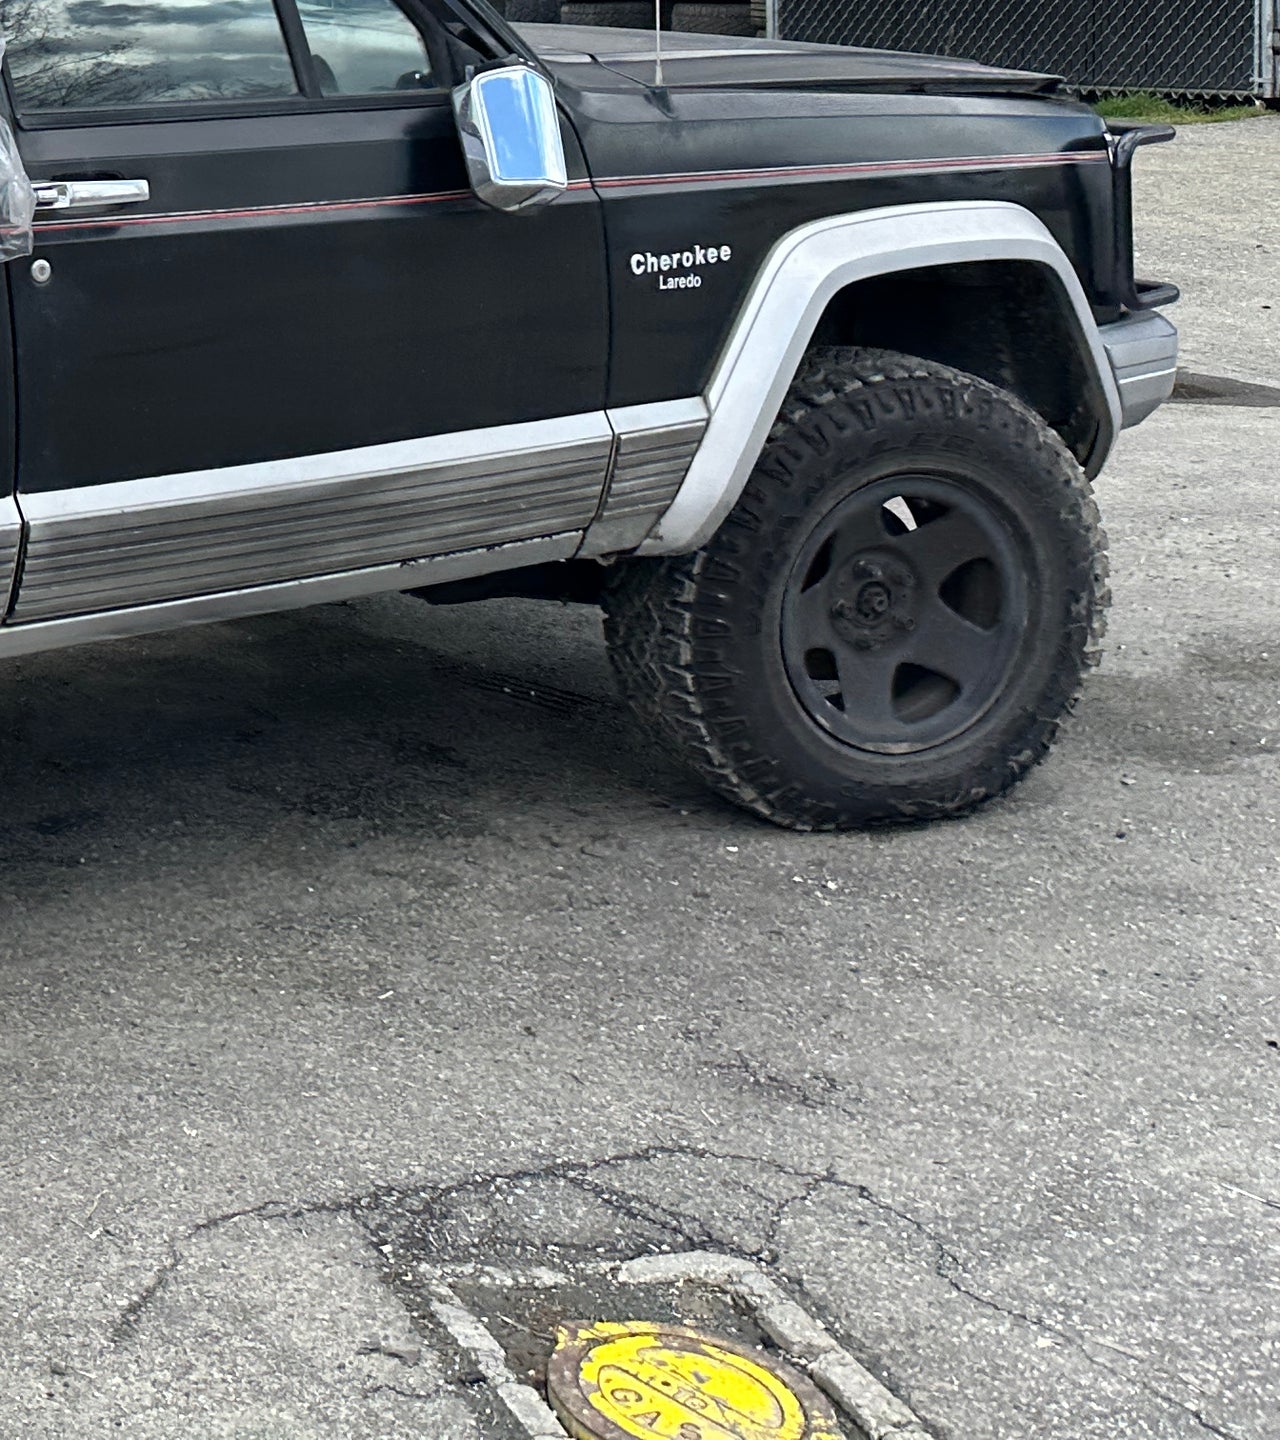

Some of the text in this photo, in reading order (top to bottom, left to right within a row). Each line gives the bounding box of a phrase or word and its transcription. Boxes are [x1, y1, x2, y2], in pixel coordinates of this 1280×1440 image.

[629, 244, 732, 275] Cherokee
[658, 273, 702, 290] Laredo
[609, 1387, 703, 1440] GAS
